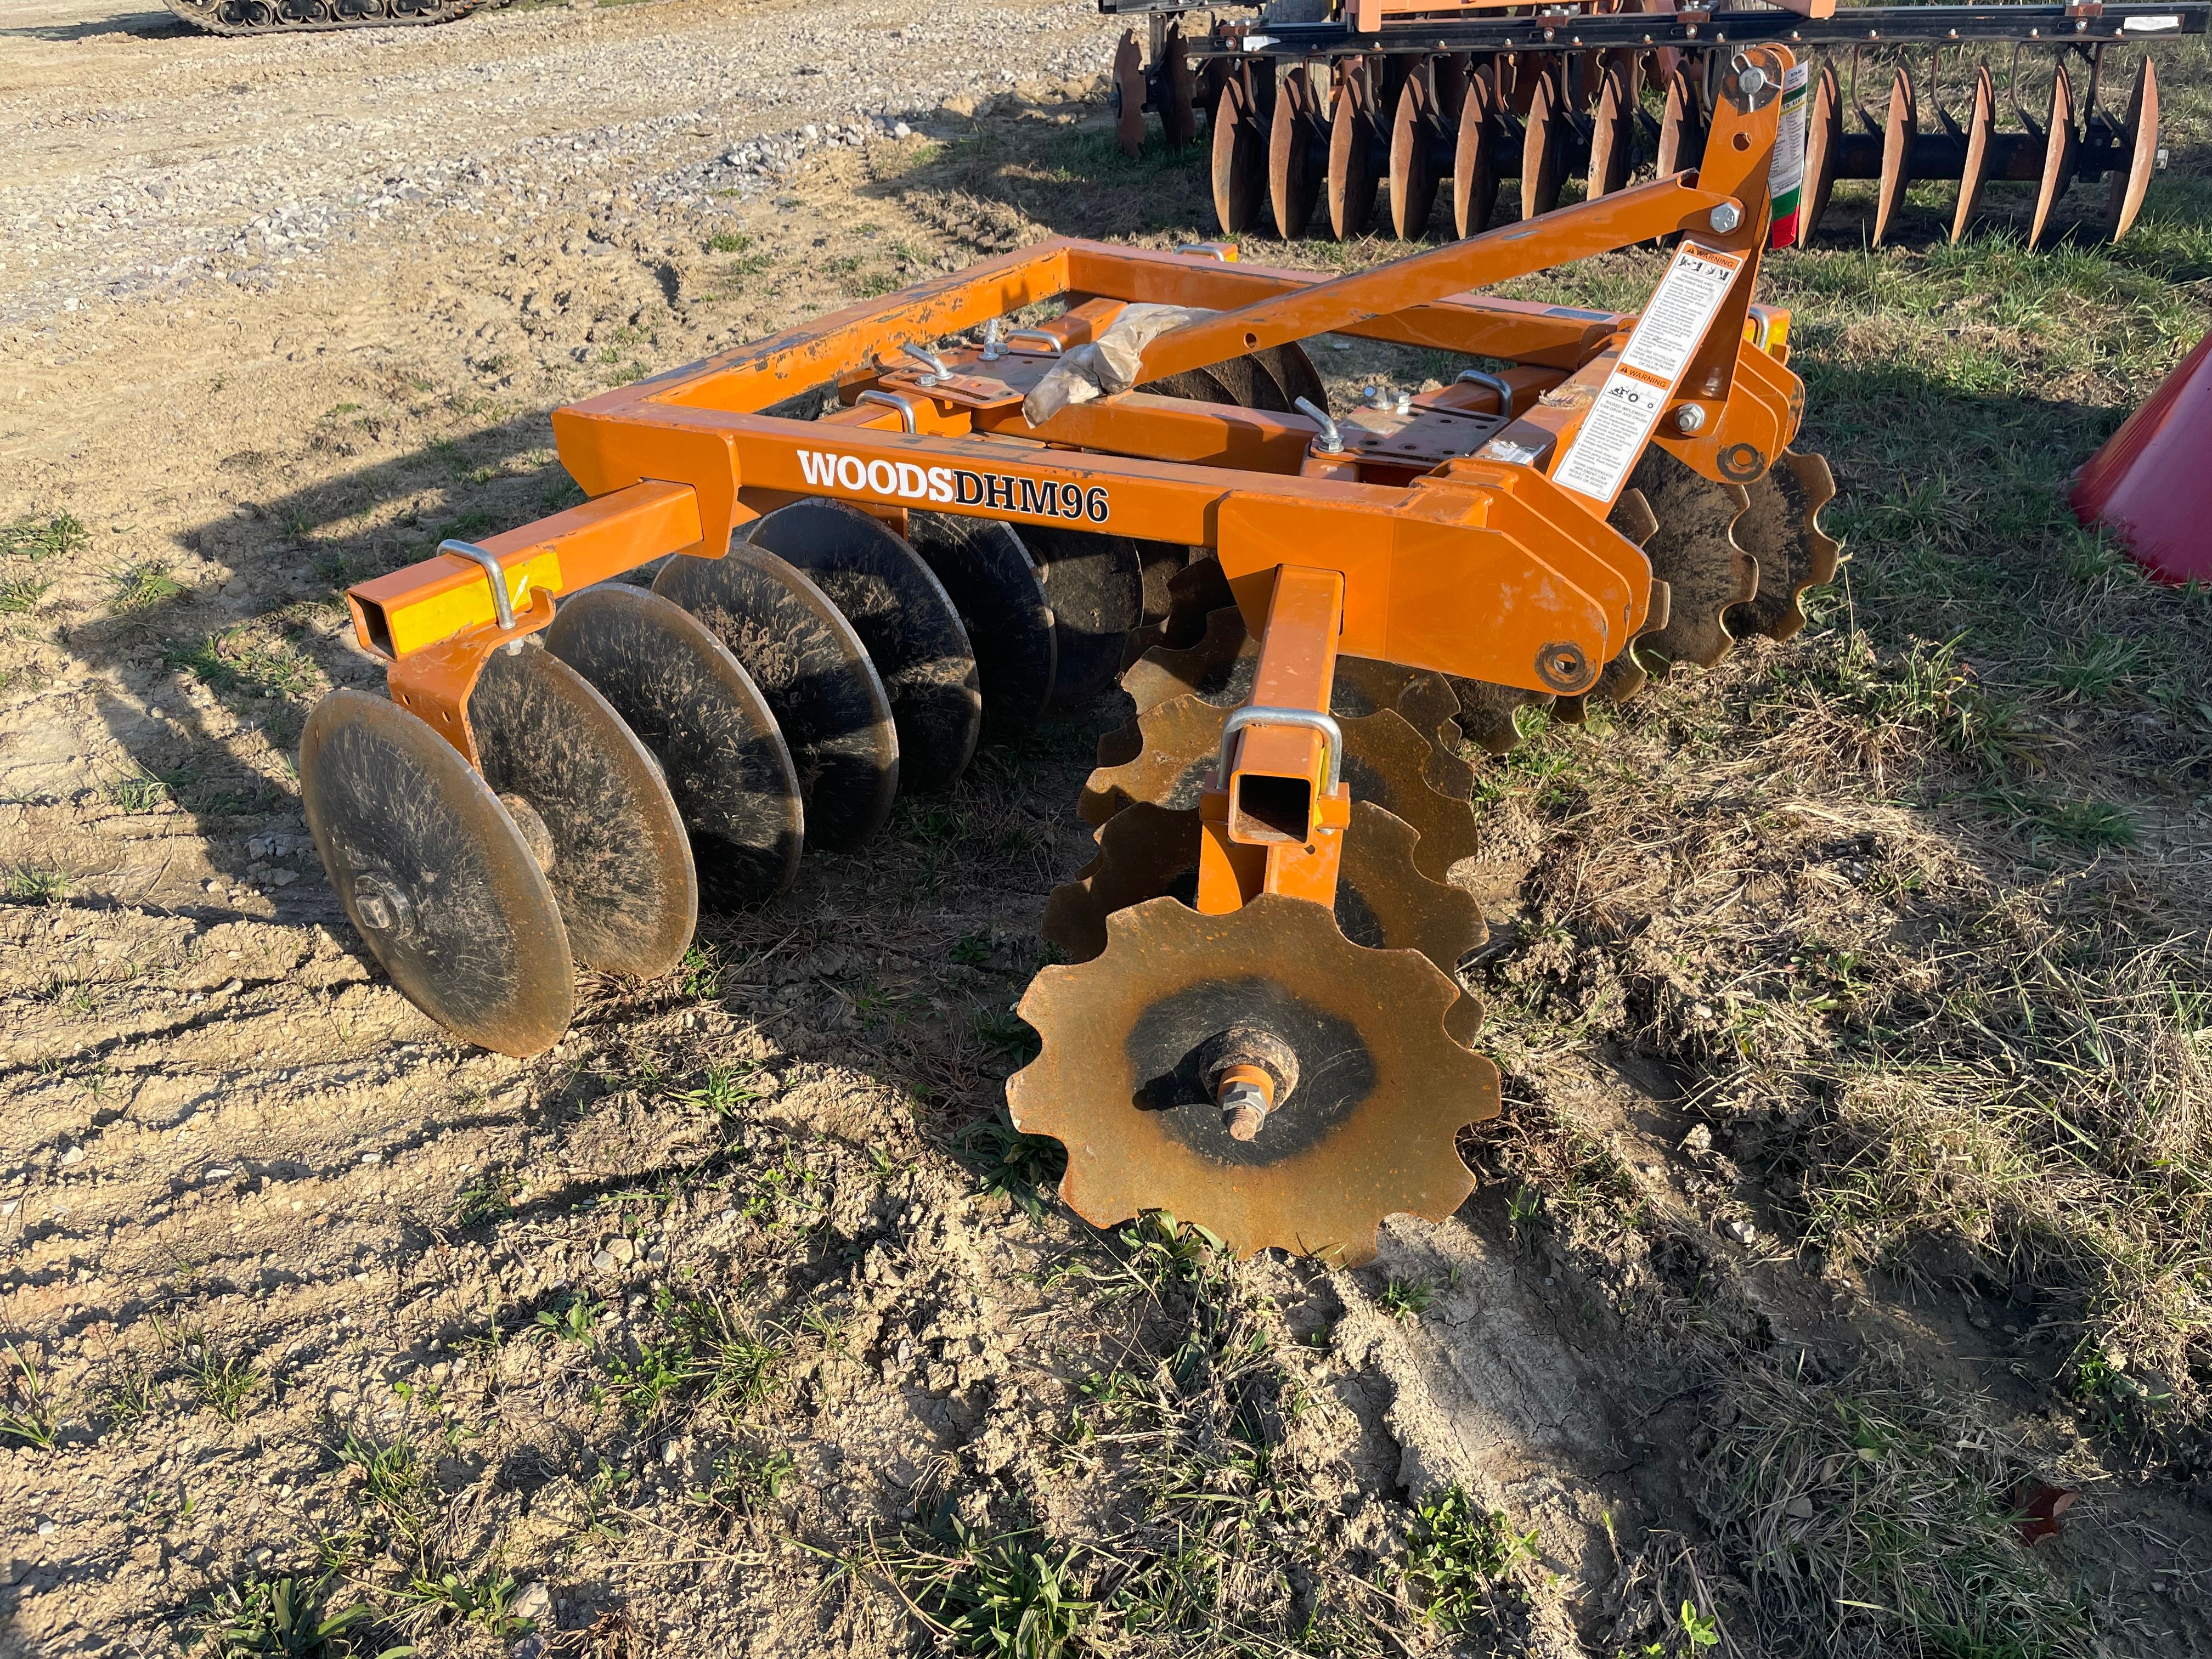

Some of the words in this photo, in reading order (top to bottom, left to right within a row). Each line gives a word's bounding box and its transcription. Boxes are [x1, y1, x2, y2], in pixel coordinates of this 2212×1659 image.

[1694, 249, 1734, 268] WARNING
[1628, 369, 1667, 388] WARNING
[797, 450, 953, 503] WOODS
[953, 470, 1109, 523] DHM96
